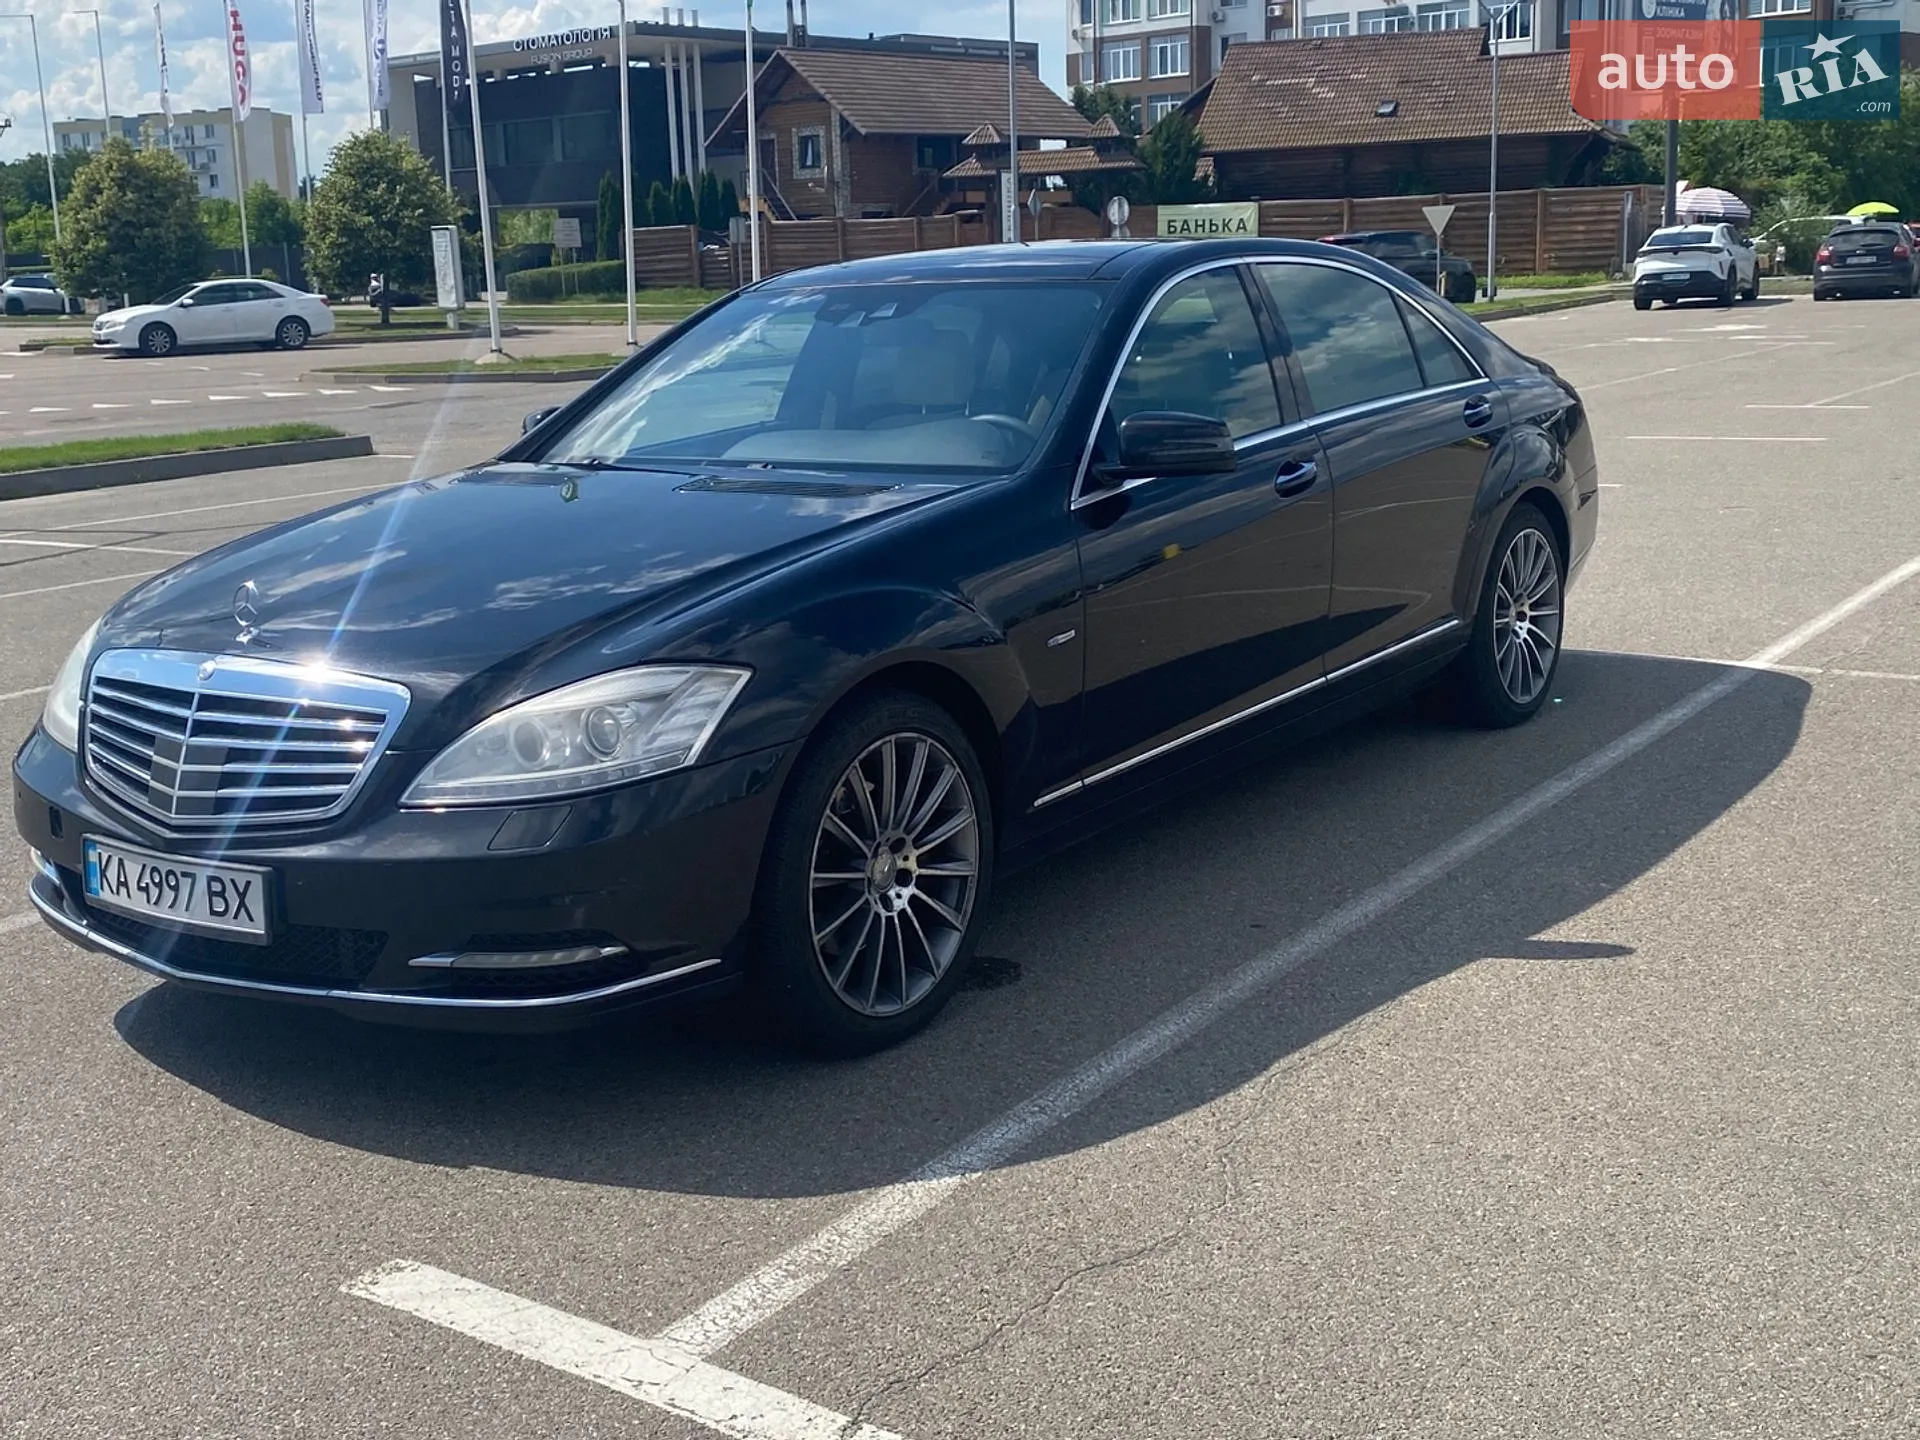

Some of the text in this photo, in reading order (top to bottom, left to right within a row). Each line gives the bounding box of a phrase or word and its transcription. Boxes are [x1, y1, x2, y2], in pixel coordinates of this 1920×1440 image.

[513, 26, 611, 52] СТОМАТОЛОГІЯ
[563, 48, 593, 61] GROUP
[1167, 218, 1248, 235] БАНЬКА
[99, 852, 255, 922] KA 4997 BX
